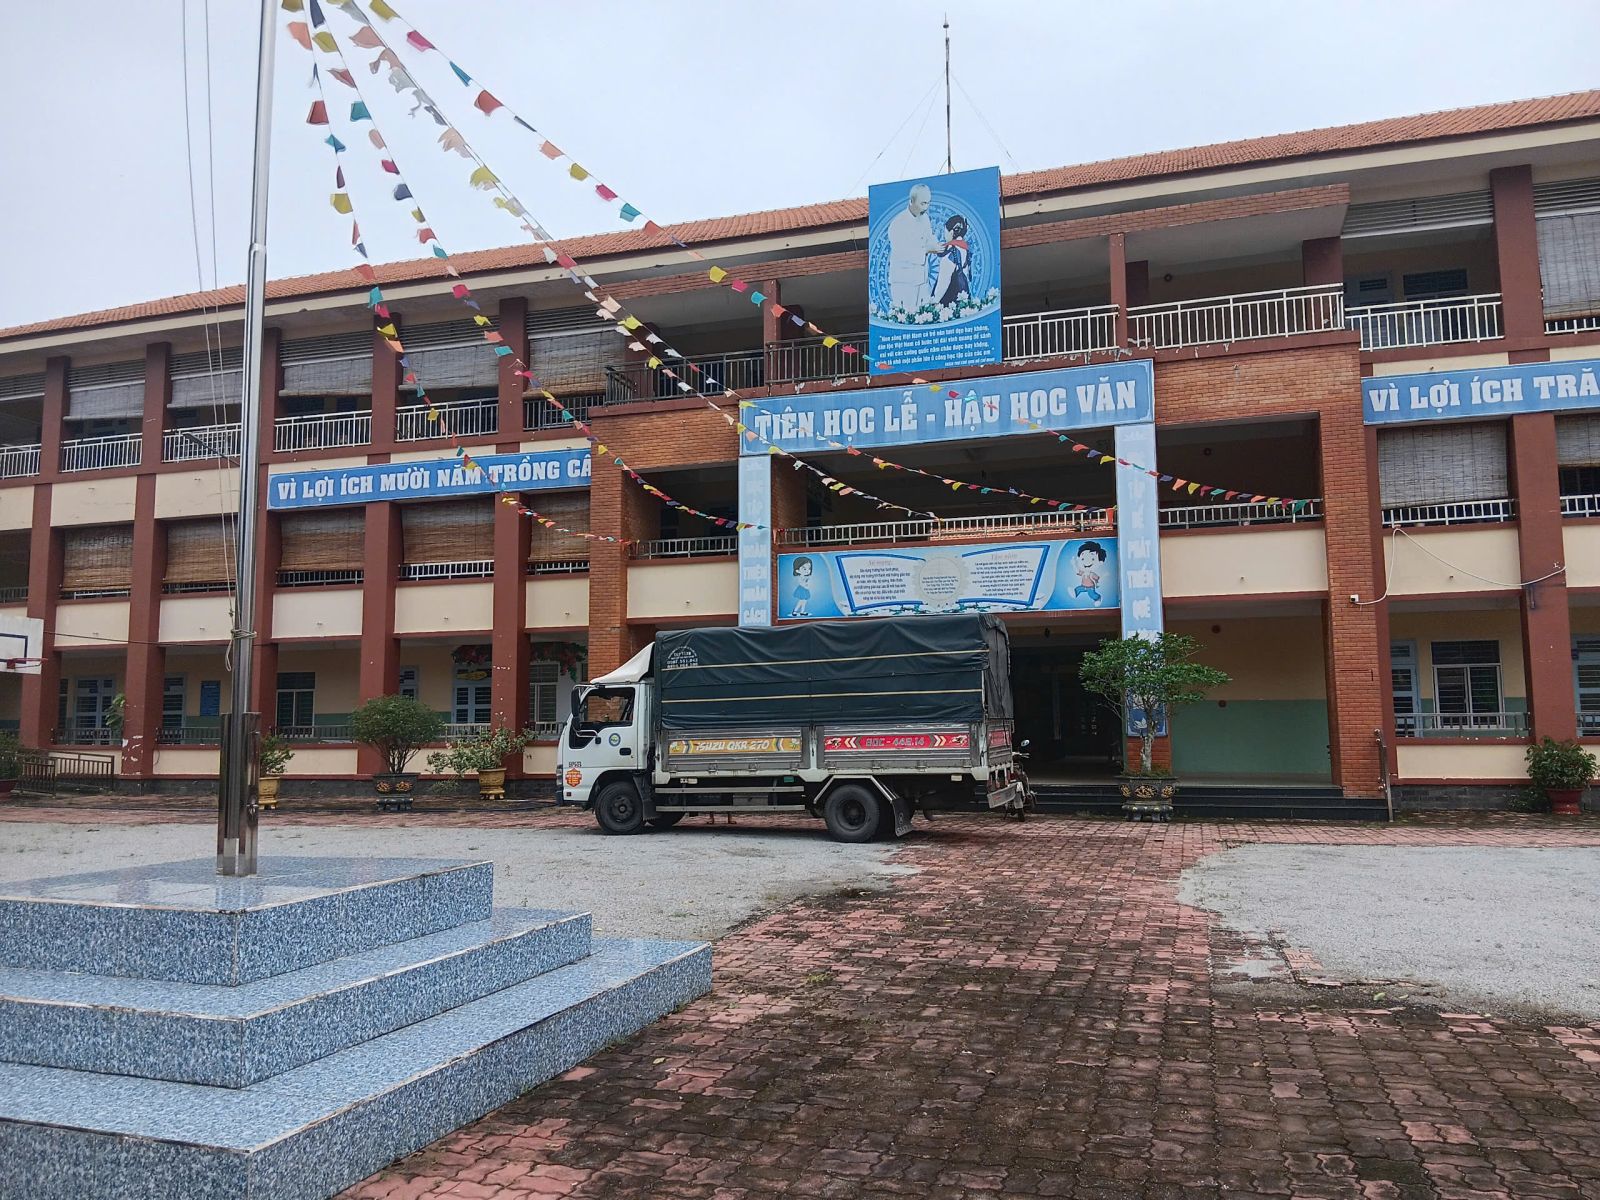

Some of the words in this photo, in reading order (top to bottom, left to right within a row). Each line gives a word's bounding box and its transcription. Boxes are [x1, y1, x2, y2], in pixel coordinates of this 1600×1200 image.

[755, 406, 814, 443] TIÊN
[824, 407, 875, 441] HỌC
[884, 391, 917, 432] LỄ
[945, 390, 1000, 432] HẬU
[1010, 389, 1067, 424] HỌC
[1076, 376, 1136, 413] VĂN
[1369, 383, 1400, 412] VÌ
[1410, 380, 1460, 414] LỢI
[1470, 376, 1524, 404] ÍCH
[1533, 368, 1600, 399] TRĂ
[278, 478, 296, 500] VÌ
[302, 476, 334, 502] LỢI
[340, 474, 374, 496] ÍCH
[380, 467, 430, 492] MƯỜI
[437, 464, 482, 488] NĂM
[488, 456, 560, 483] TRỒNG
